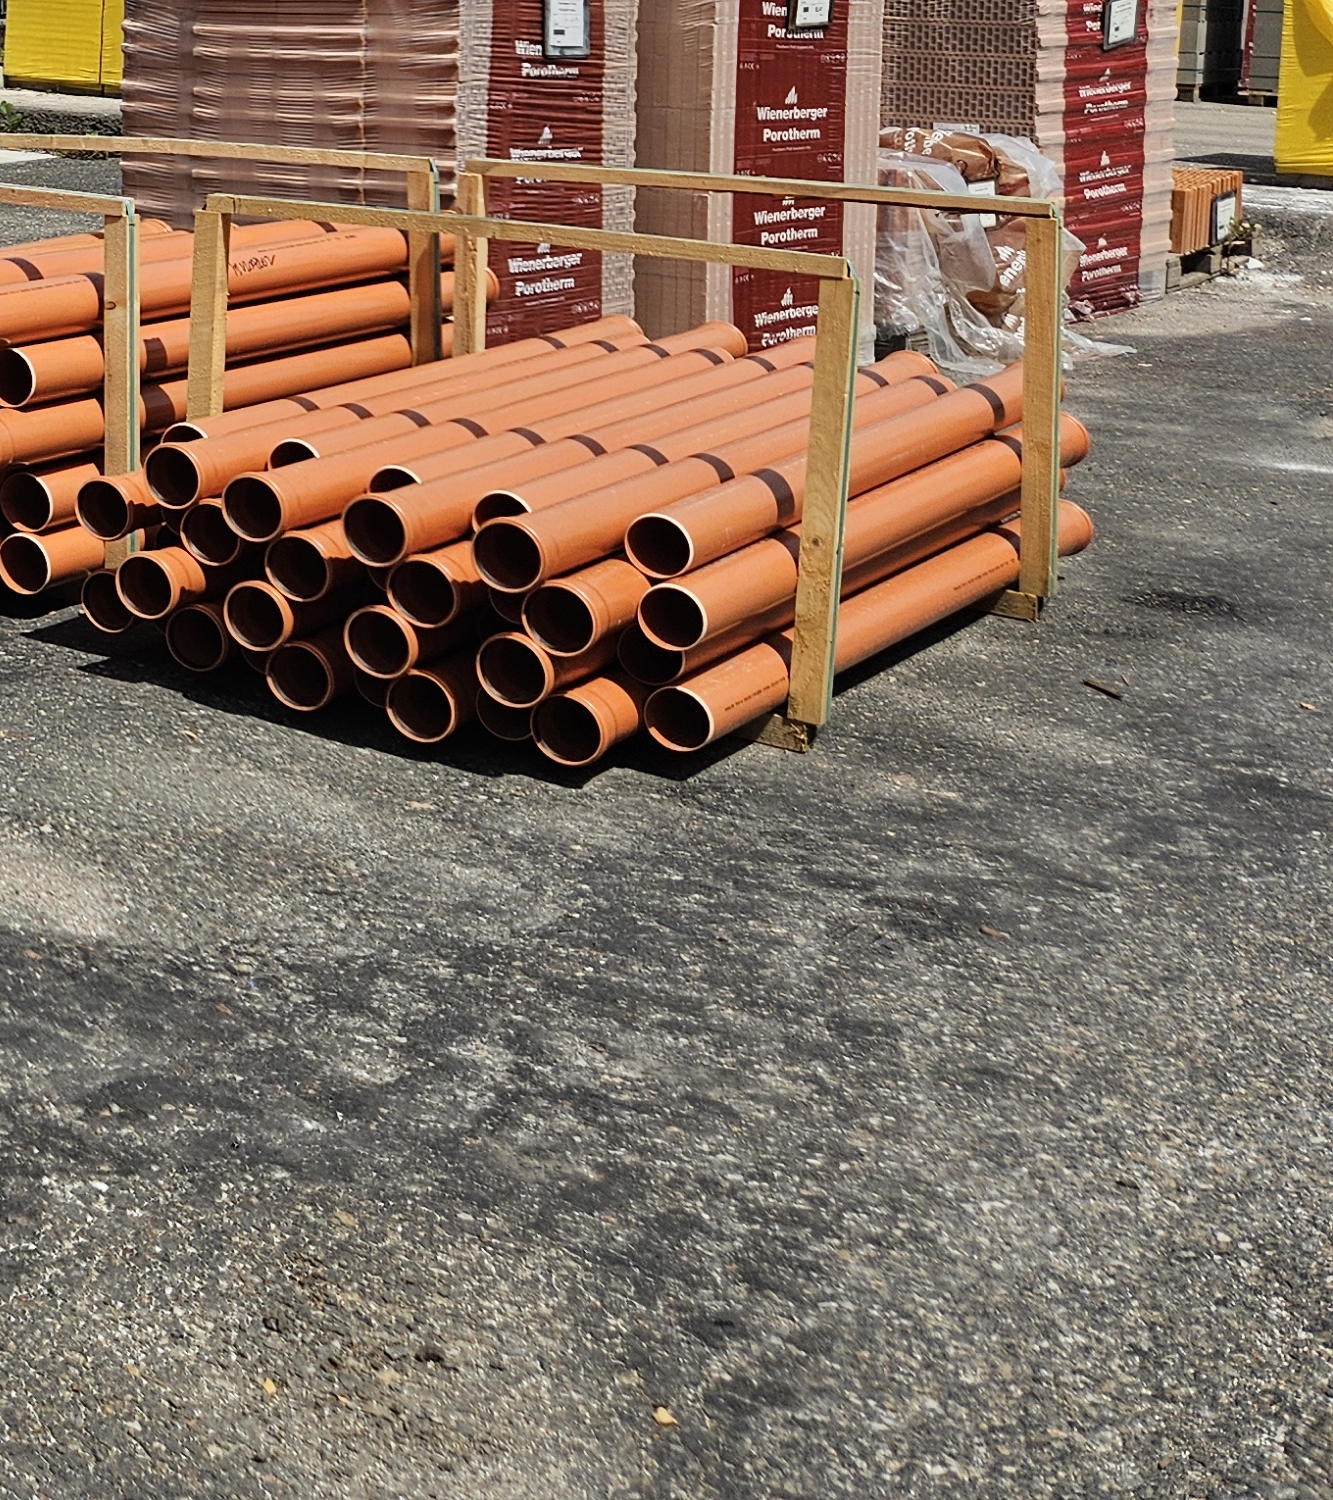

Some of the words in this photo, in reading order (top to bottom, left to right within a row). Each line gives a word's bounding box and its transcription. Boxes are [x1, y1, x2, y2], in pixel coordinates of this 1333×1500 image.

[757, 106, 828, 120] Wienerberger
[763, 127, 820, 142] Porotherm
[754, 206, 825, 225] Wienerberger
[761, 228, 818, 245] Porotherm
[508, 252, 582, 274] Wienerberger
[515, 276, 575, 297] Porotherm
[754, 304, 819, 328] Wienerberge
